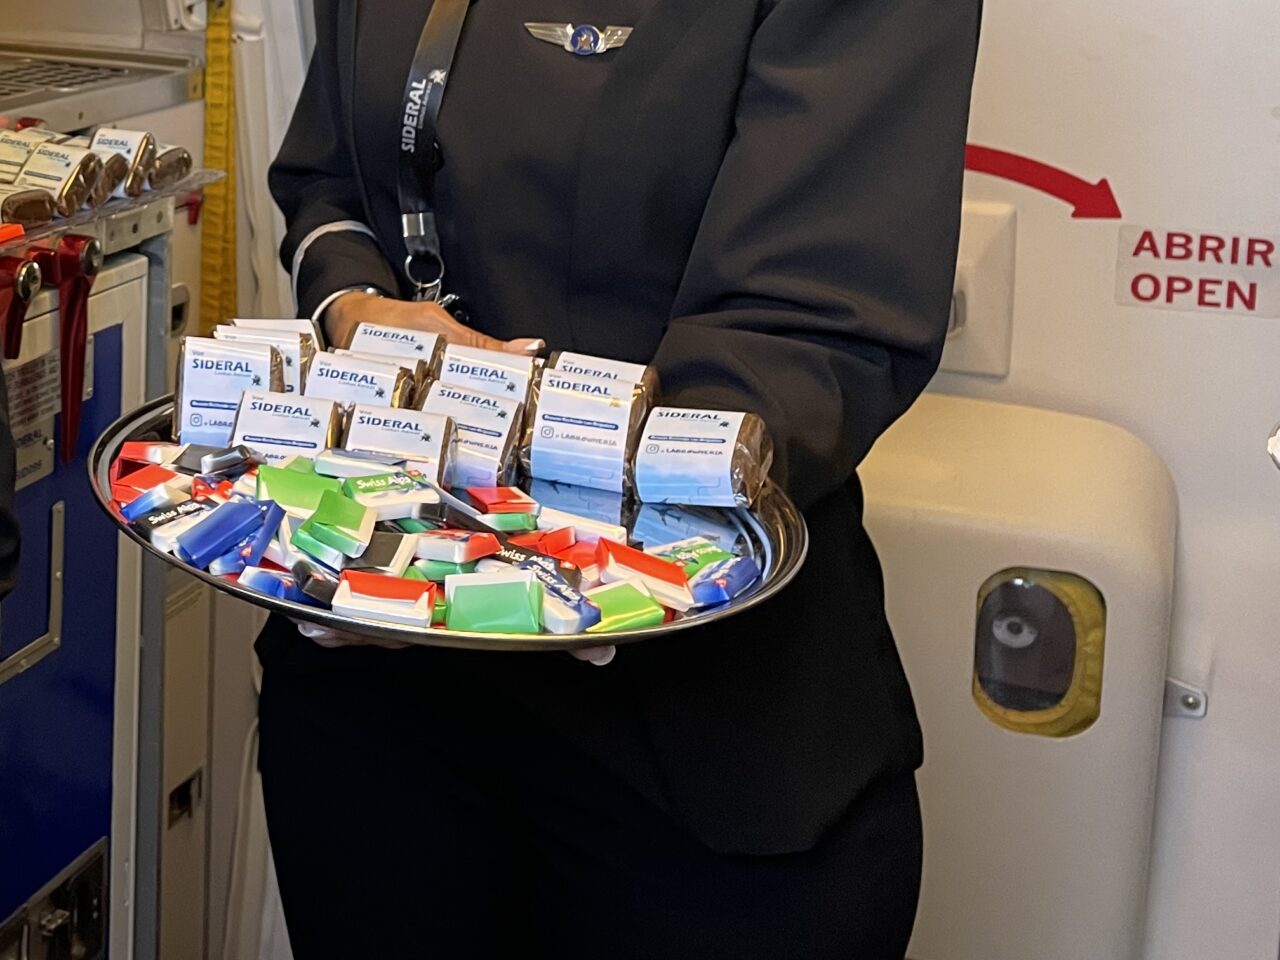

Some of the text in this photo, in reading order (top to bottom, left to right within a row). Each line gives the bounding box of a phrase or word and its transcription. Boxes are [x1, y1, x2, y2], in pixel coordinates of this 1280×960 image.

[401, 79, 427, 153] SIDERAL
[1131, 230, 1276, 268] ABRIR
[1130, 273, 1258, 311] OPEN
[361, 328, 417, 343] SIDERAL
[192, 358, 253, 373] SIDERAL
[447, 363, 508, 380] SIDERAL
[317, 368, 377, 385] SIDERAL
[548, 379, 611, 395] SIDERAL
[438, 389, 500, 408] SIDERAL
[250, 401, 312, 417] SIDERAL
[657, 411, 722, 420] SIDERAL
[357, 416, 423, 431] SIDERAL
[356, 479, 386, 488] Swiss
[148, 509, 177, 524] Swiss
